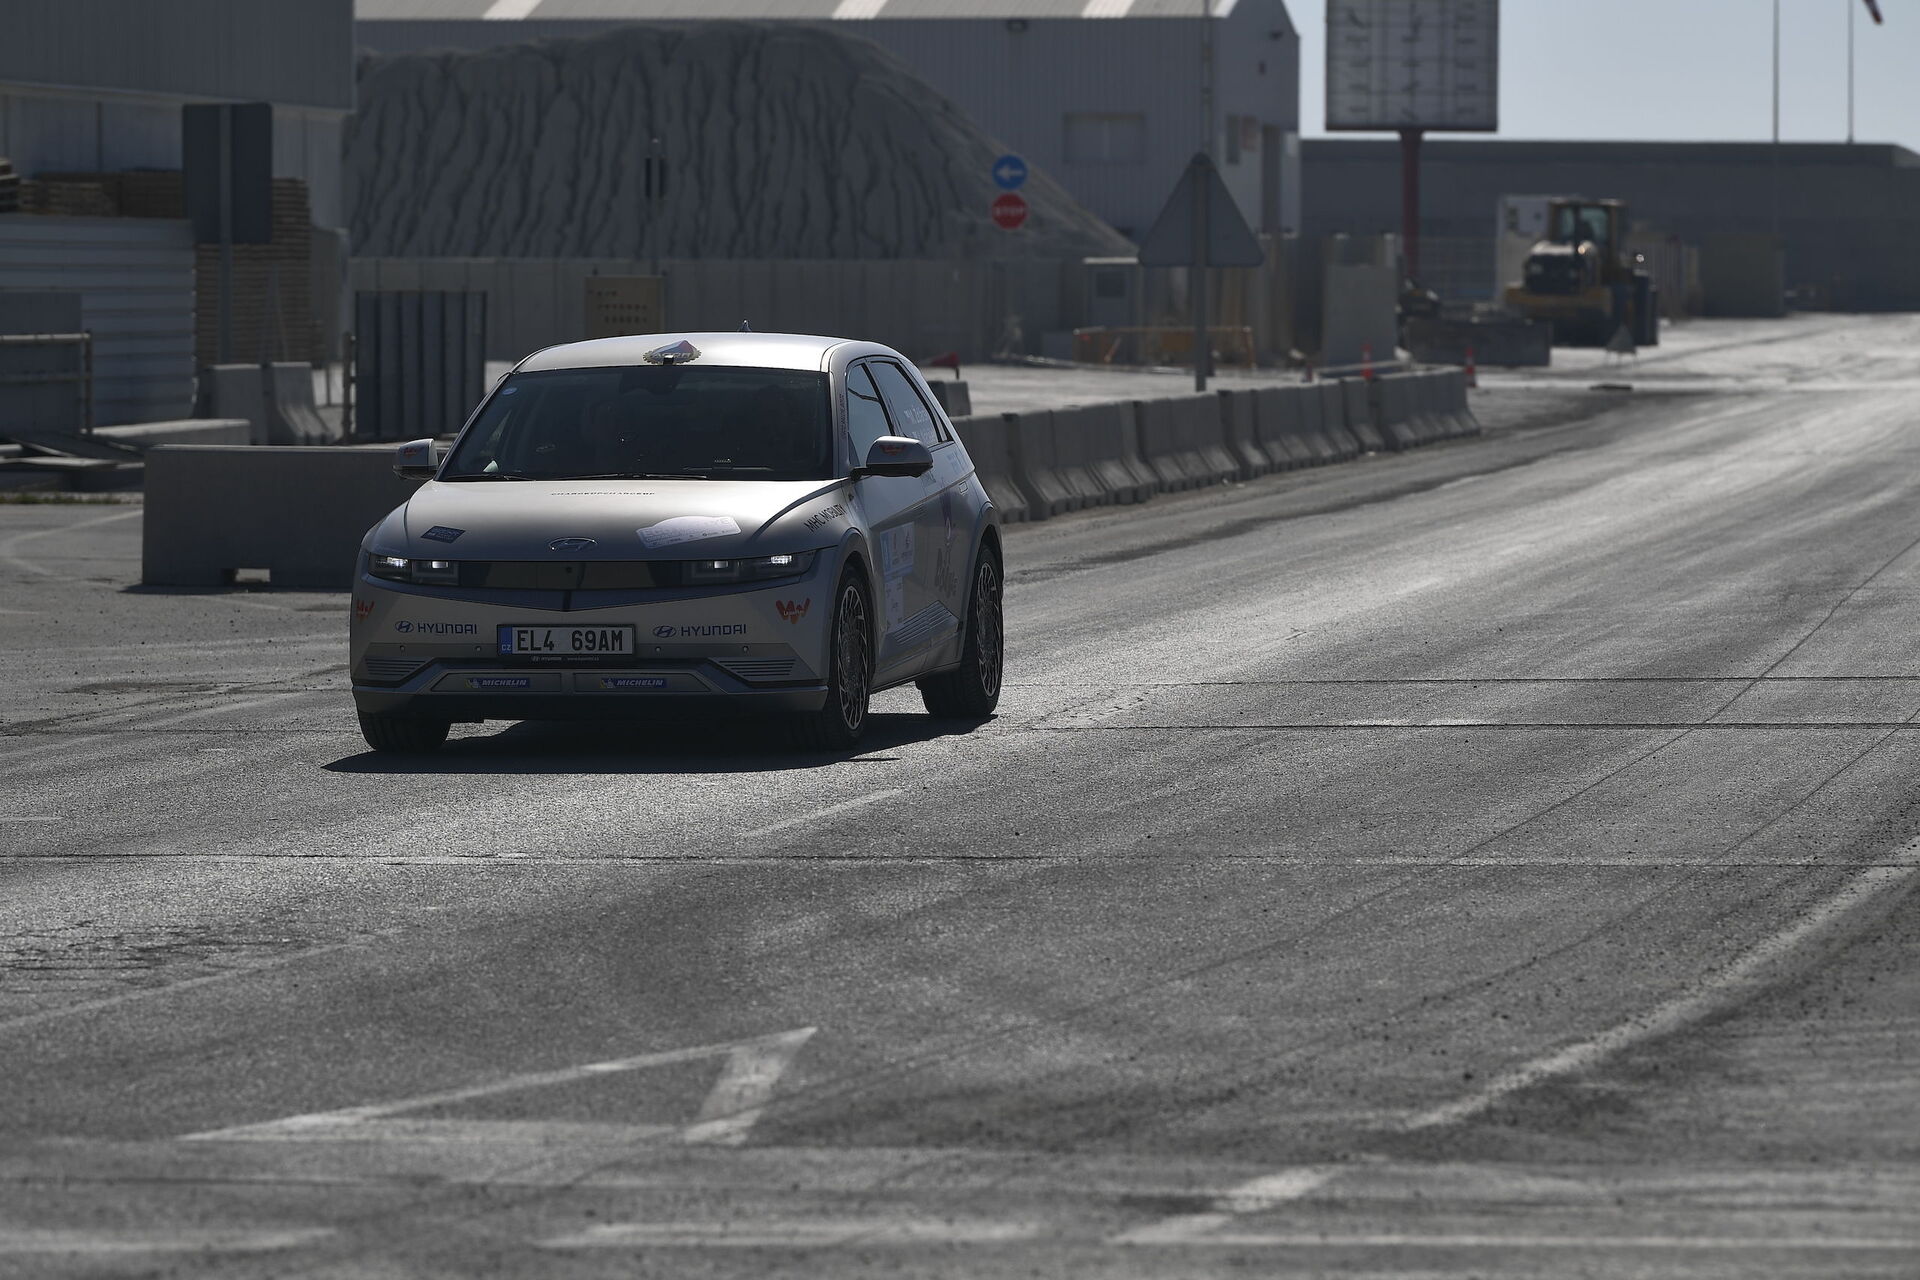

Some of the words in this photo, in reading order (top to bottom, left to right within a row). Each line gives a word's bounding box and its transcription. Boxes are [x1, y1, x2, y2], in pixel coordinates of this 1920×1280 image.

[803, 514, 826, 533] MHC
[417, 623, 477, 634] HYUNDAI
[681, 624, 747, 637] HYUNDAI
[517, 630, 555, 651] EL4
[571, 630, 623, 651] 69AM
